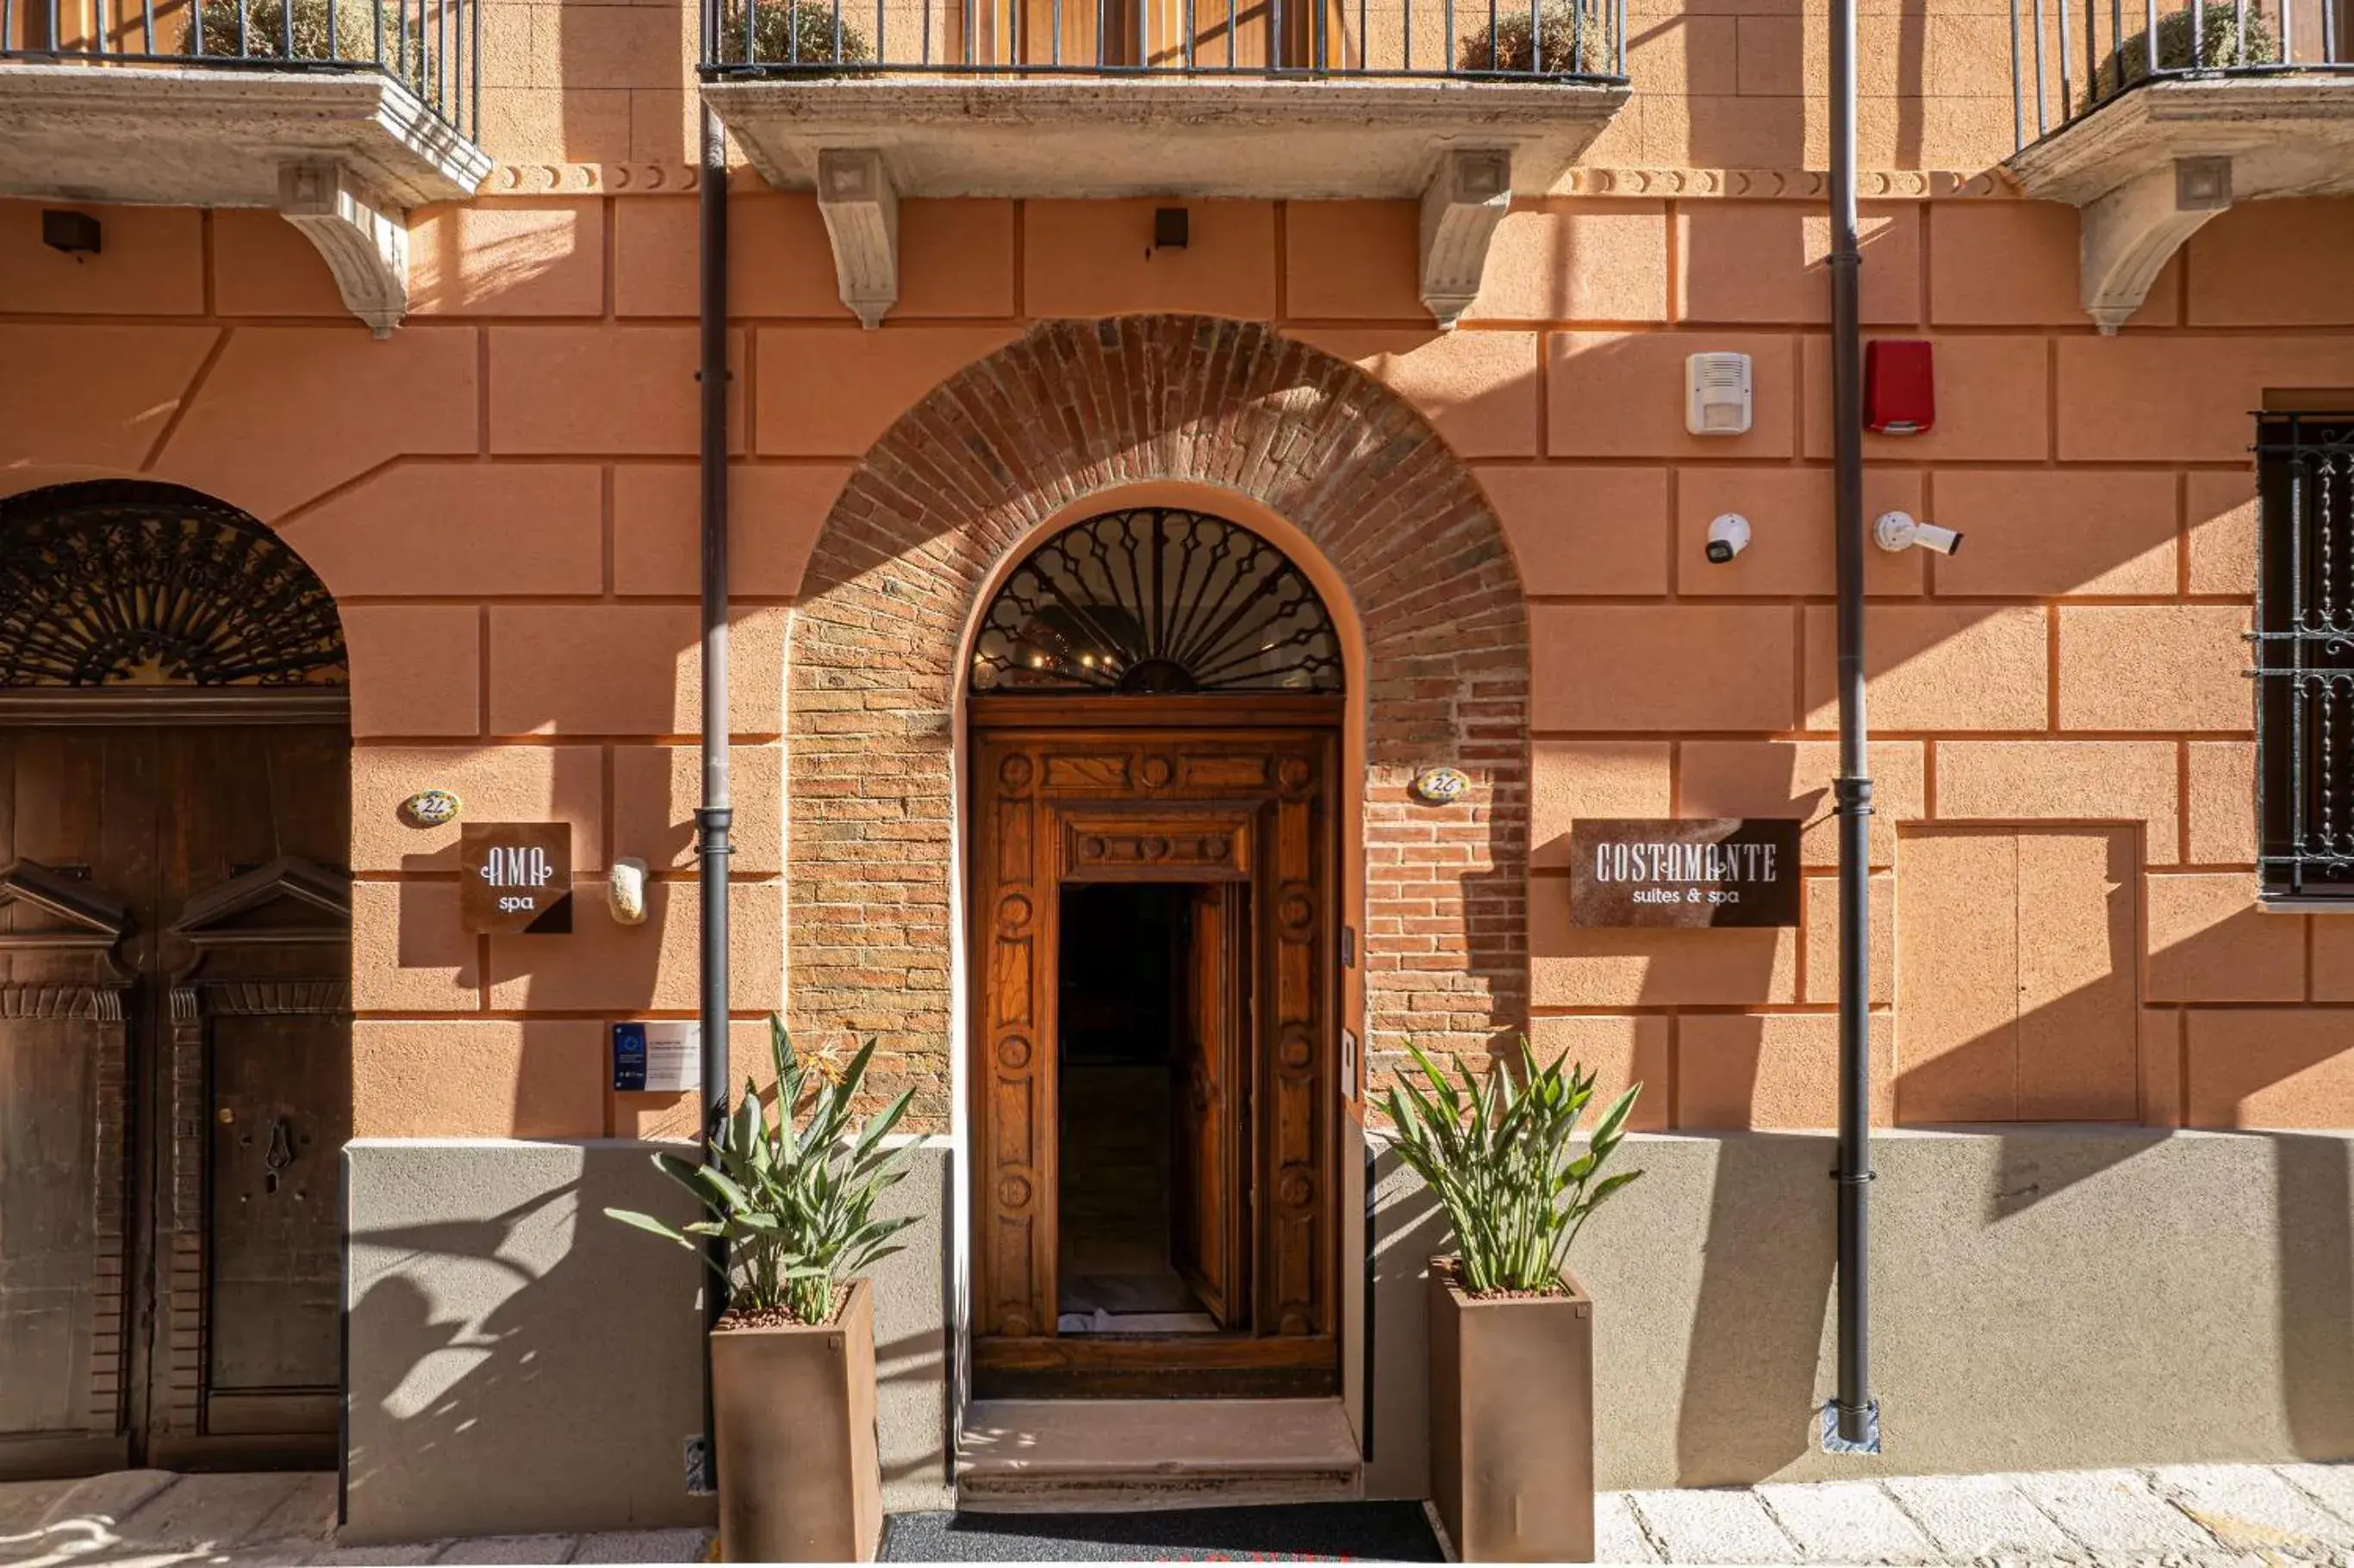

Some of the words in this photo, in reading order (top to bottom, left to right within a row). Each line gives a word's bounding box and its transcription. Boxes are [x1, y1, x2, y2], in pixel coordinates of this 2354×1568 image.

[1433, 777, 1457, 793] 26
[479, 846, 553, 887] AMA
[1596, 843, 1777, 882] COSTAMANTE
[499, 895, 534, 912] spa
[1633, 888, 1680, 905] suites
[1686, 887, 1702, 904] &
[1707, 889, 1741, 906] spa
